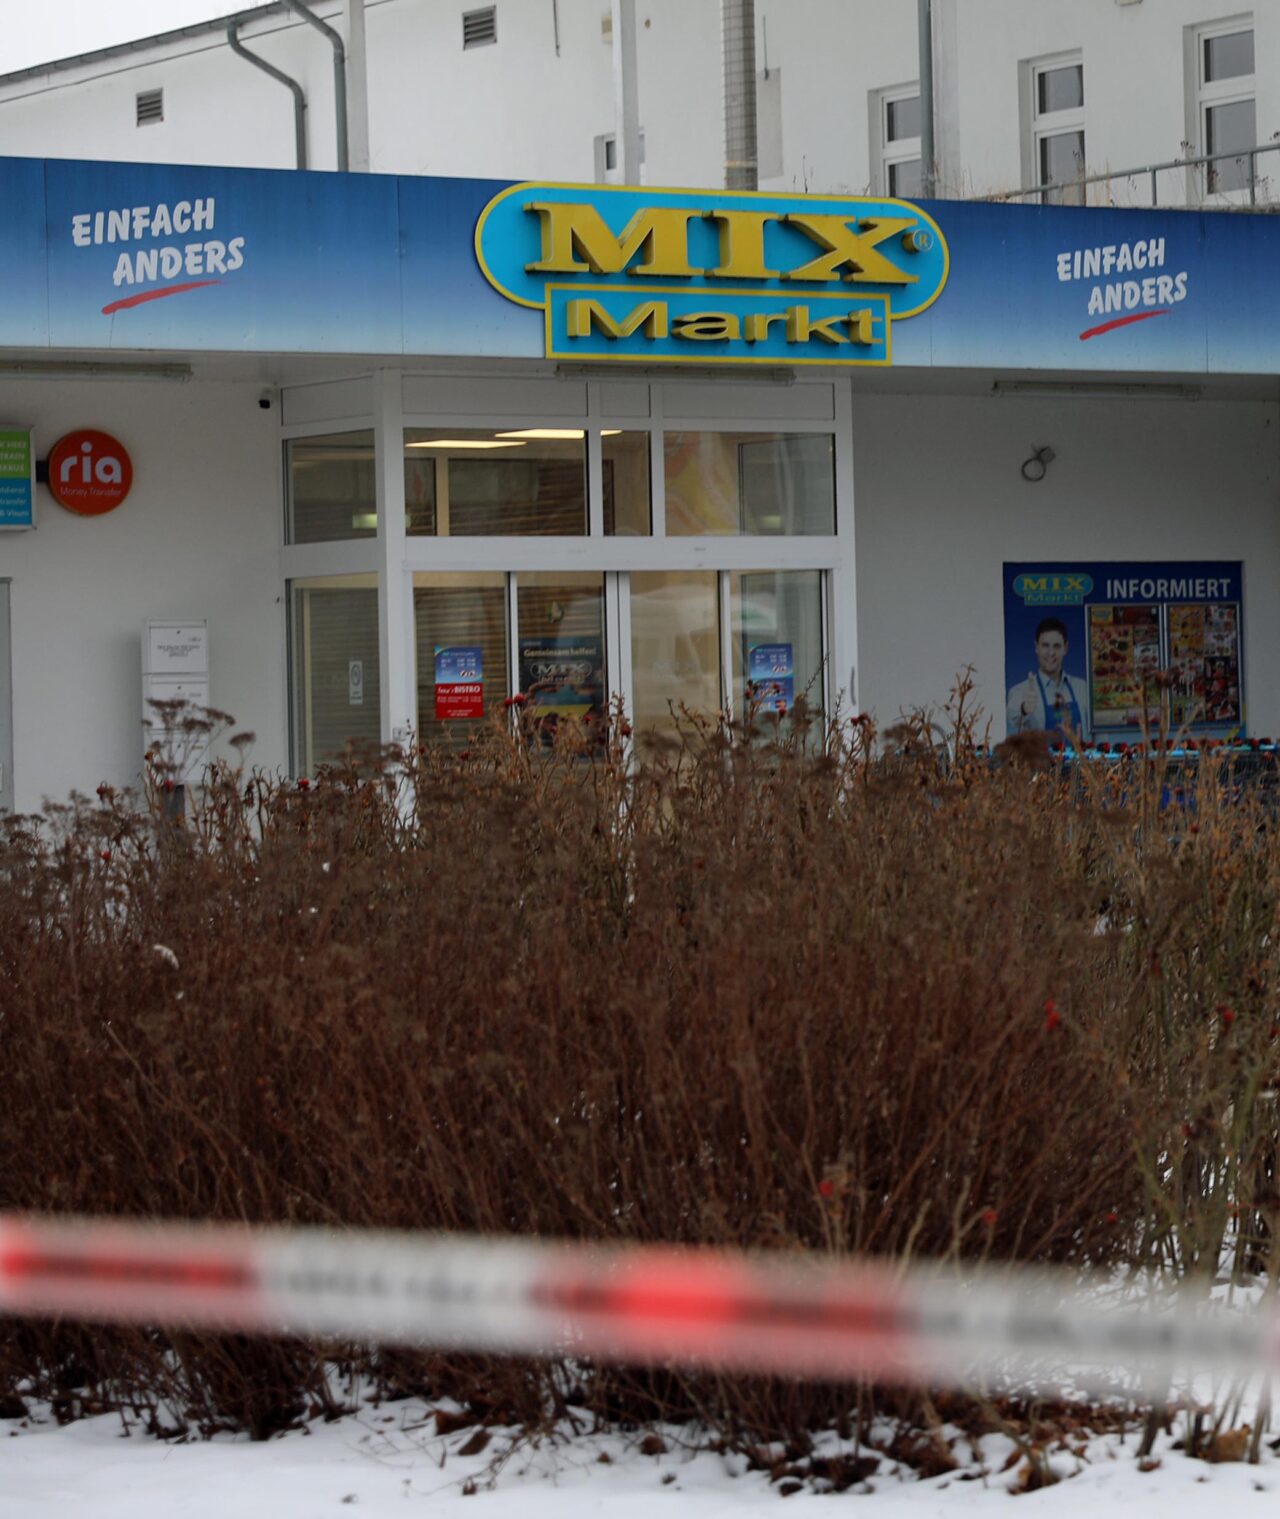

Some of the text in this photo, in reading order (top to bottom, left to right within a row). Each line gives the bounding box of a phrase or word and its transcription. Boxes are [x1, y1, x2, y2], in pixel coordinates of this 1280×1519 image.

[72, 198, 215, 247] EINFACH
[523, 201, 919, 284] MIX
[113, 237, 245, 286] ANDERS
[1057, 237, 1165, 281] EINFACH
[1088, 272, 1188, 315] ANDERS
[566, 299, 883, 345] Markt
[60, 441, 122, 484] ria
[60, 487, 87, 497] Money
[1024, 577, 1085, 591] MIX
[1106, 578, 1231, 599] INFORMIERT
